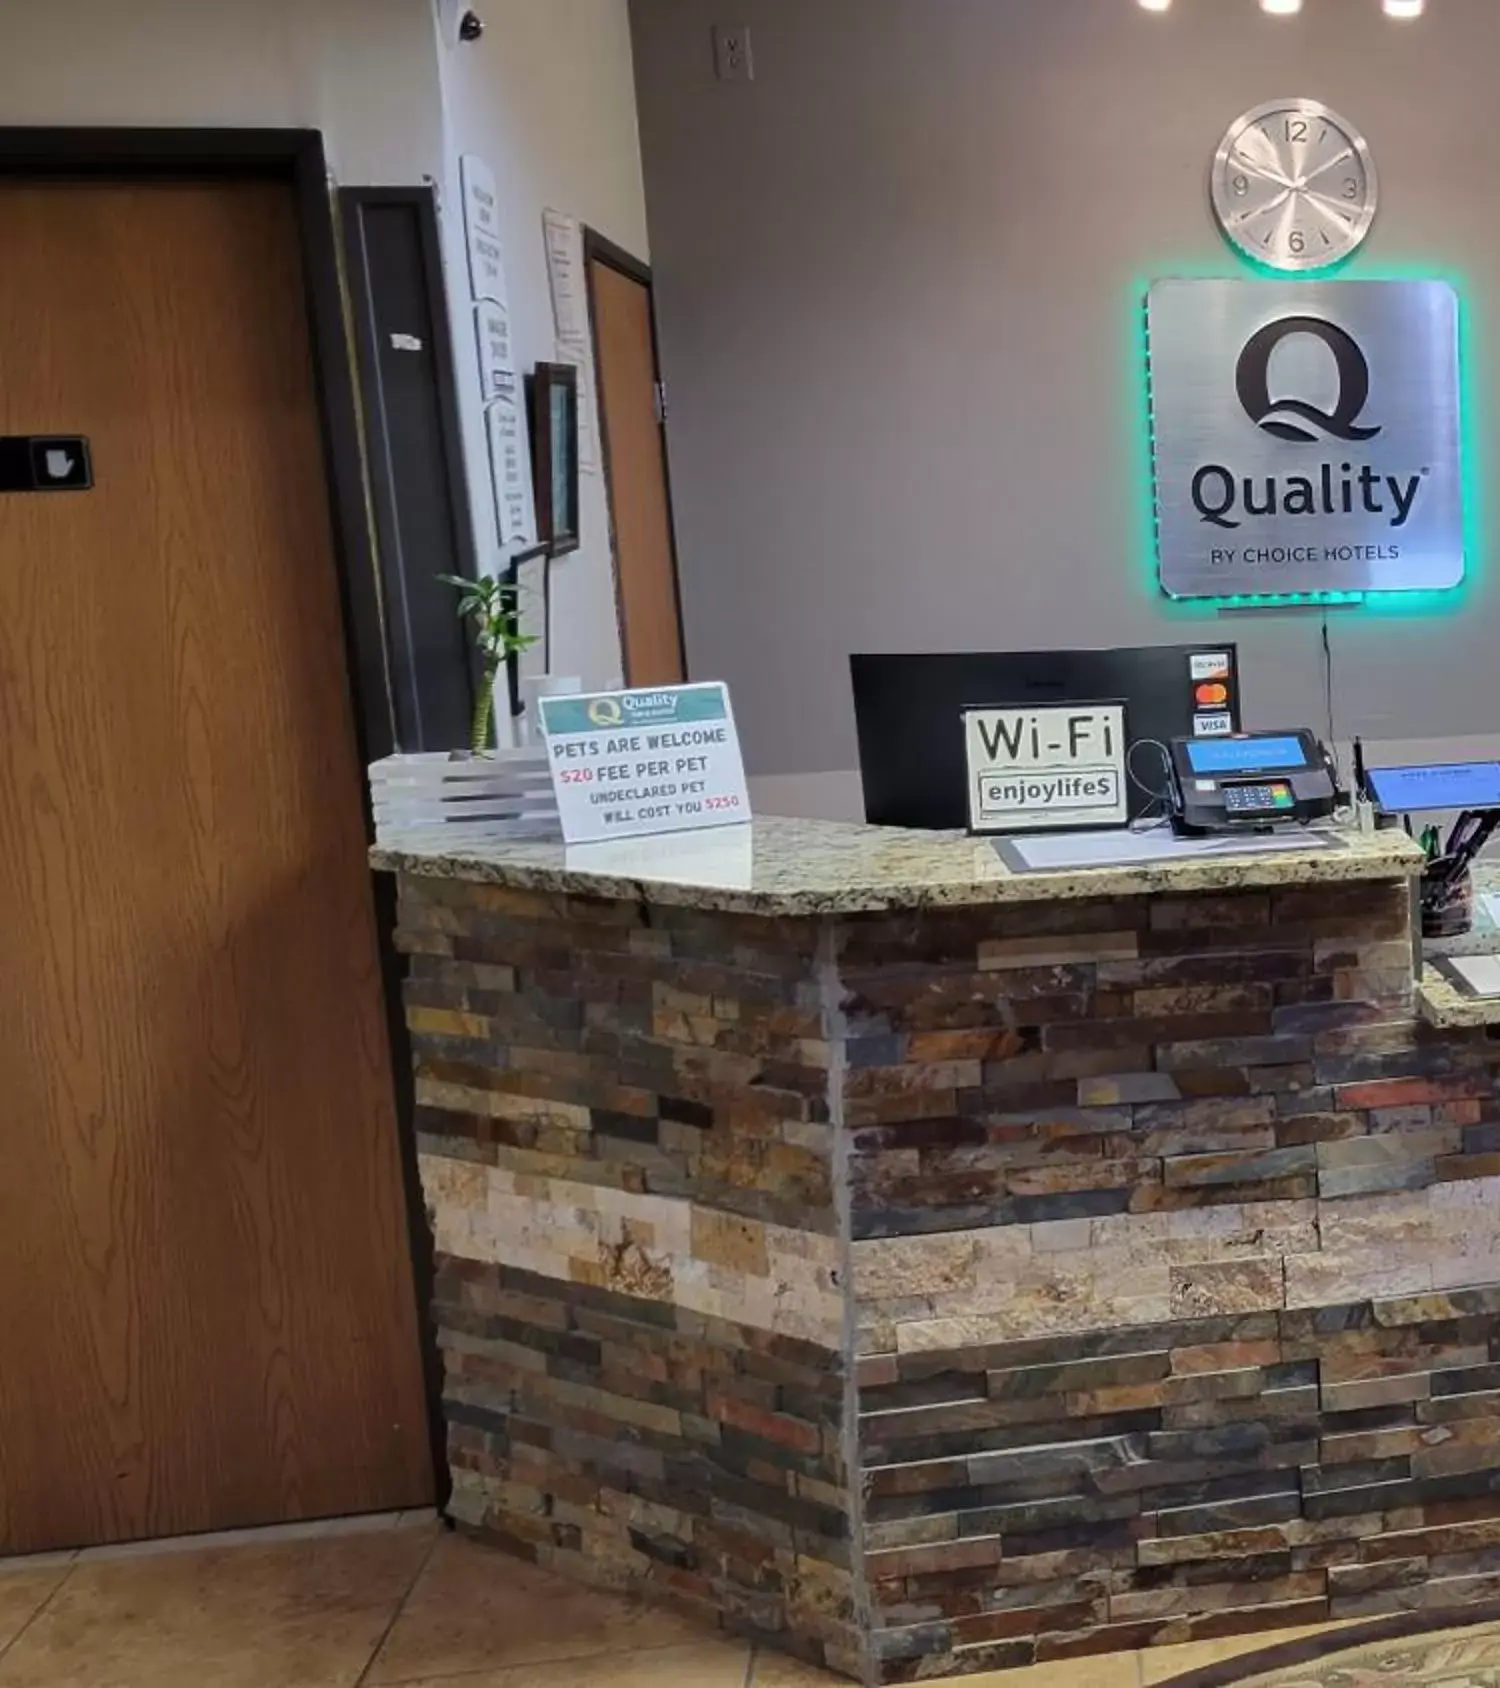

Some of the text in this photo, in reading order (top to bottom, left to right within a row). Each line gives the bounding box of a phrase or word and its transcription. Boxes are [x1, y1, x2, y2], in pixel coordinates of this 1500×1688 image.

[1284, 120, 1308, 144] 12
[1232, 175, 1248, 196] 9
[1342, 178, 1357, 198] 3
[1289, 231, 1304, 252] 6
[1235, 314, 1382, 443] Q
[1192, 462, 1421, 529] Quality
[1243, 547, 1318, 563] CHOICE
[1325, 545, 1399, 561] HOTELS
[623, 693, 678, 711] Quality
[1201, 719, 1227, 731] VISA
[553, 728, 727, 758] PETS ARE WELCOME
[977, 715, 1113, 761] Wi-Fi
[597, 764, 630, 782] FEE
[636, 760, 670, 778] PER
[676, 756, 708, 773] PET
[590, 781, 706, 805] UNDECLARED PET
[604, 811, 635, 824] WILL
[638, 806, 671, 819] COST
[676, 802, 702, 816] YOU
